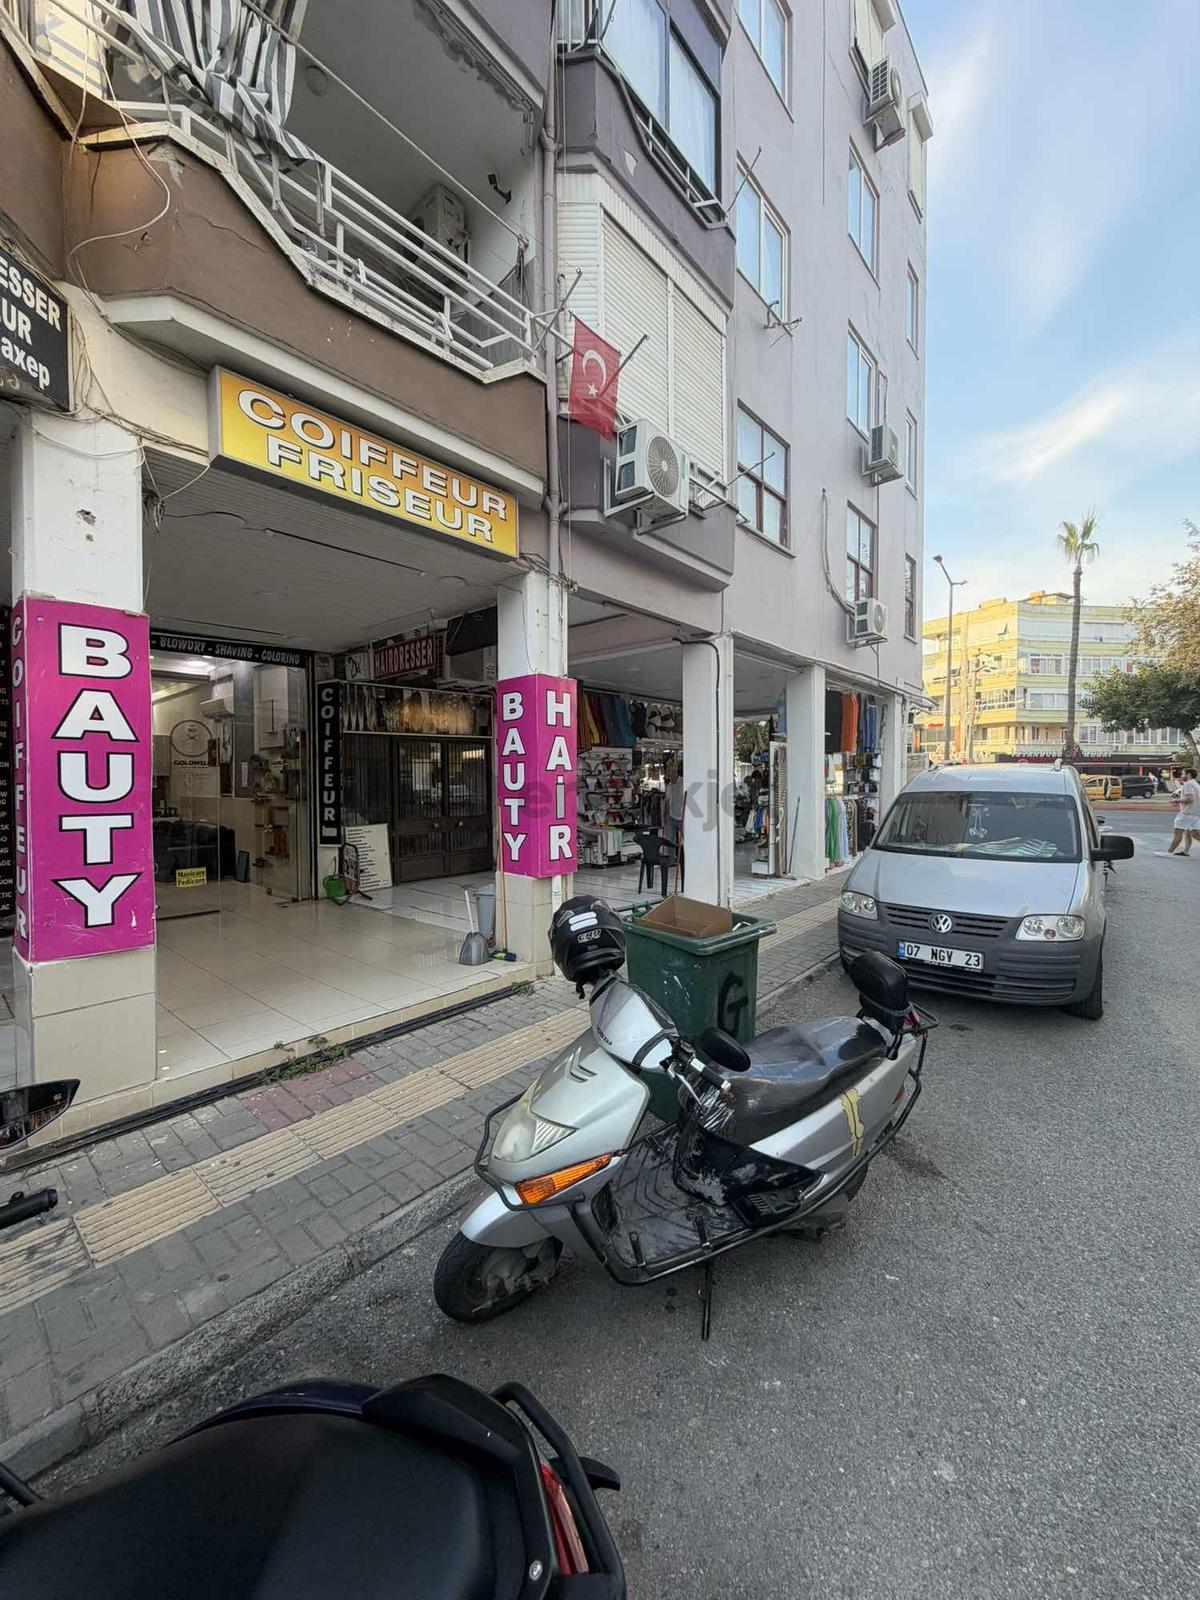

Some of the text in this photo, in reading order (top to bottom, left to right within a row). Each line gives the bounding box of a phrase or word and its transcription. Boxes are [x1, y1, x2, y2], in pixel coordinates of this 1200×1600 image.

[238, 389, 507, 521] COIFFEUR
[266, 433, 493, 543] FRISEUR
[160, 636, 206, 653] BLOWDRY
[214, 644, 253, 659] SHAVING
[261, 649, 300, 665] COLORING
[375, 638, 434, 676] HAIRDRESSER
[12, 615, 28, 941] COIFFEUR
[51, 622, 143, 928] BAUTY
[321, 687, 336, 822] COIFFEUR
[501, 691, 527, 862] BAUTY
[906, 944, 921, 957] 07
[964, 953, 981, 967] 23
